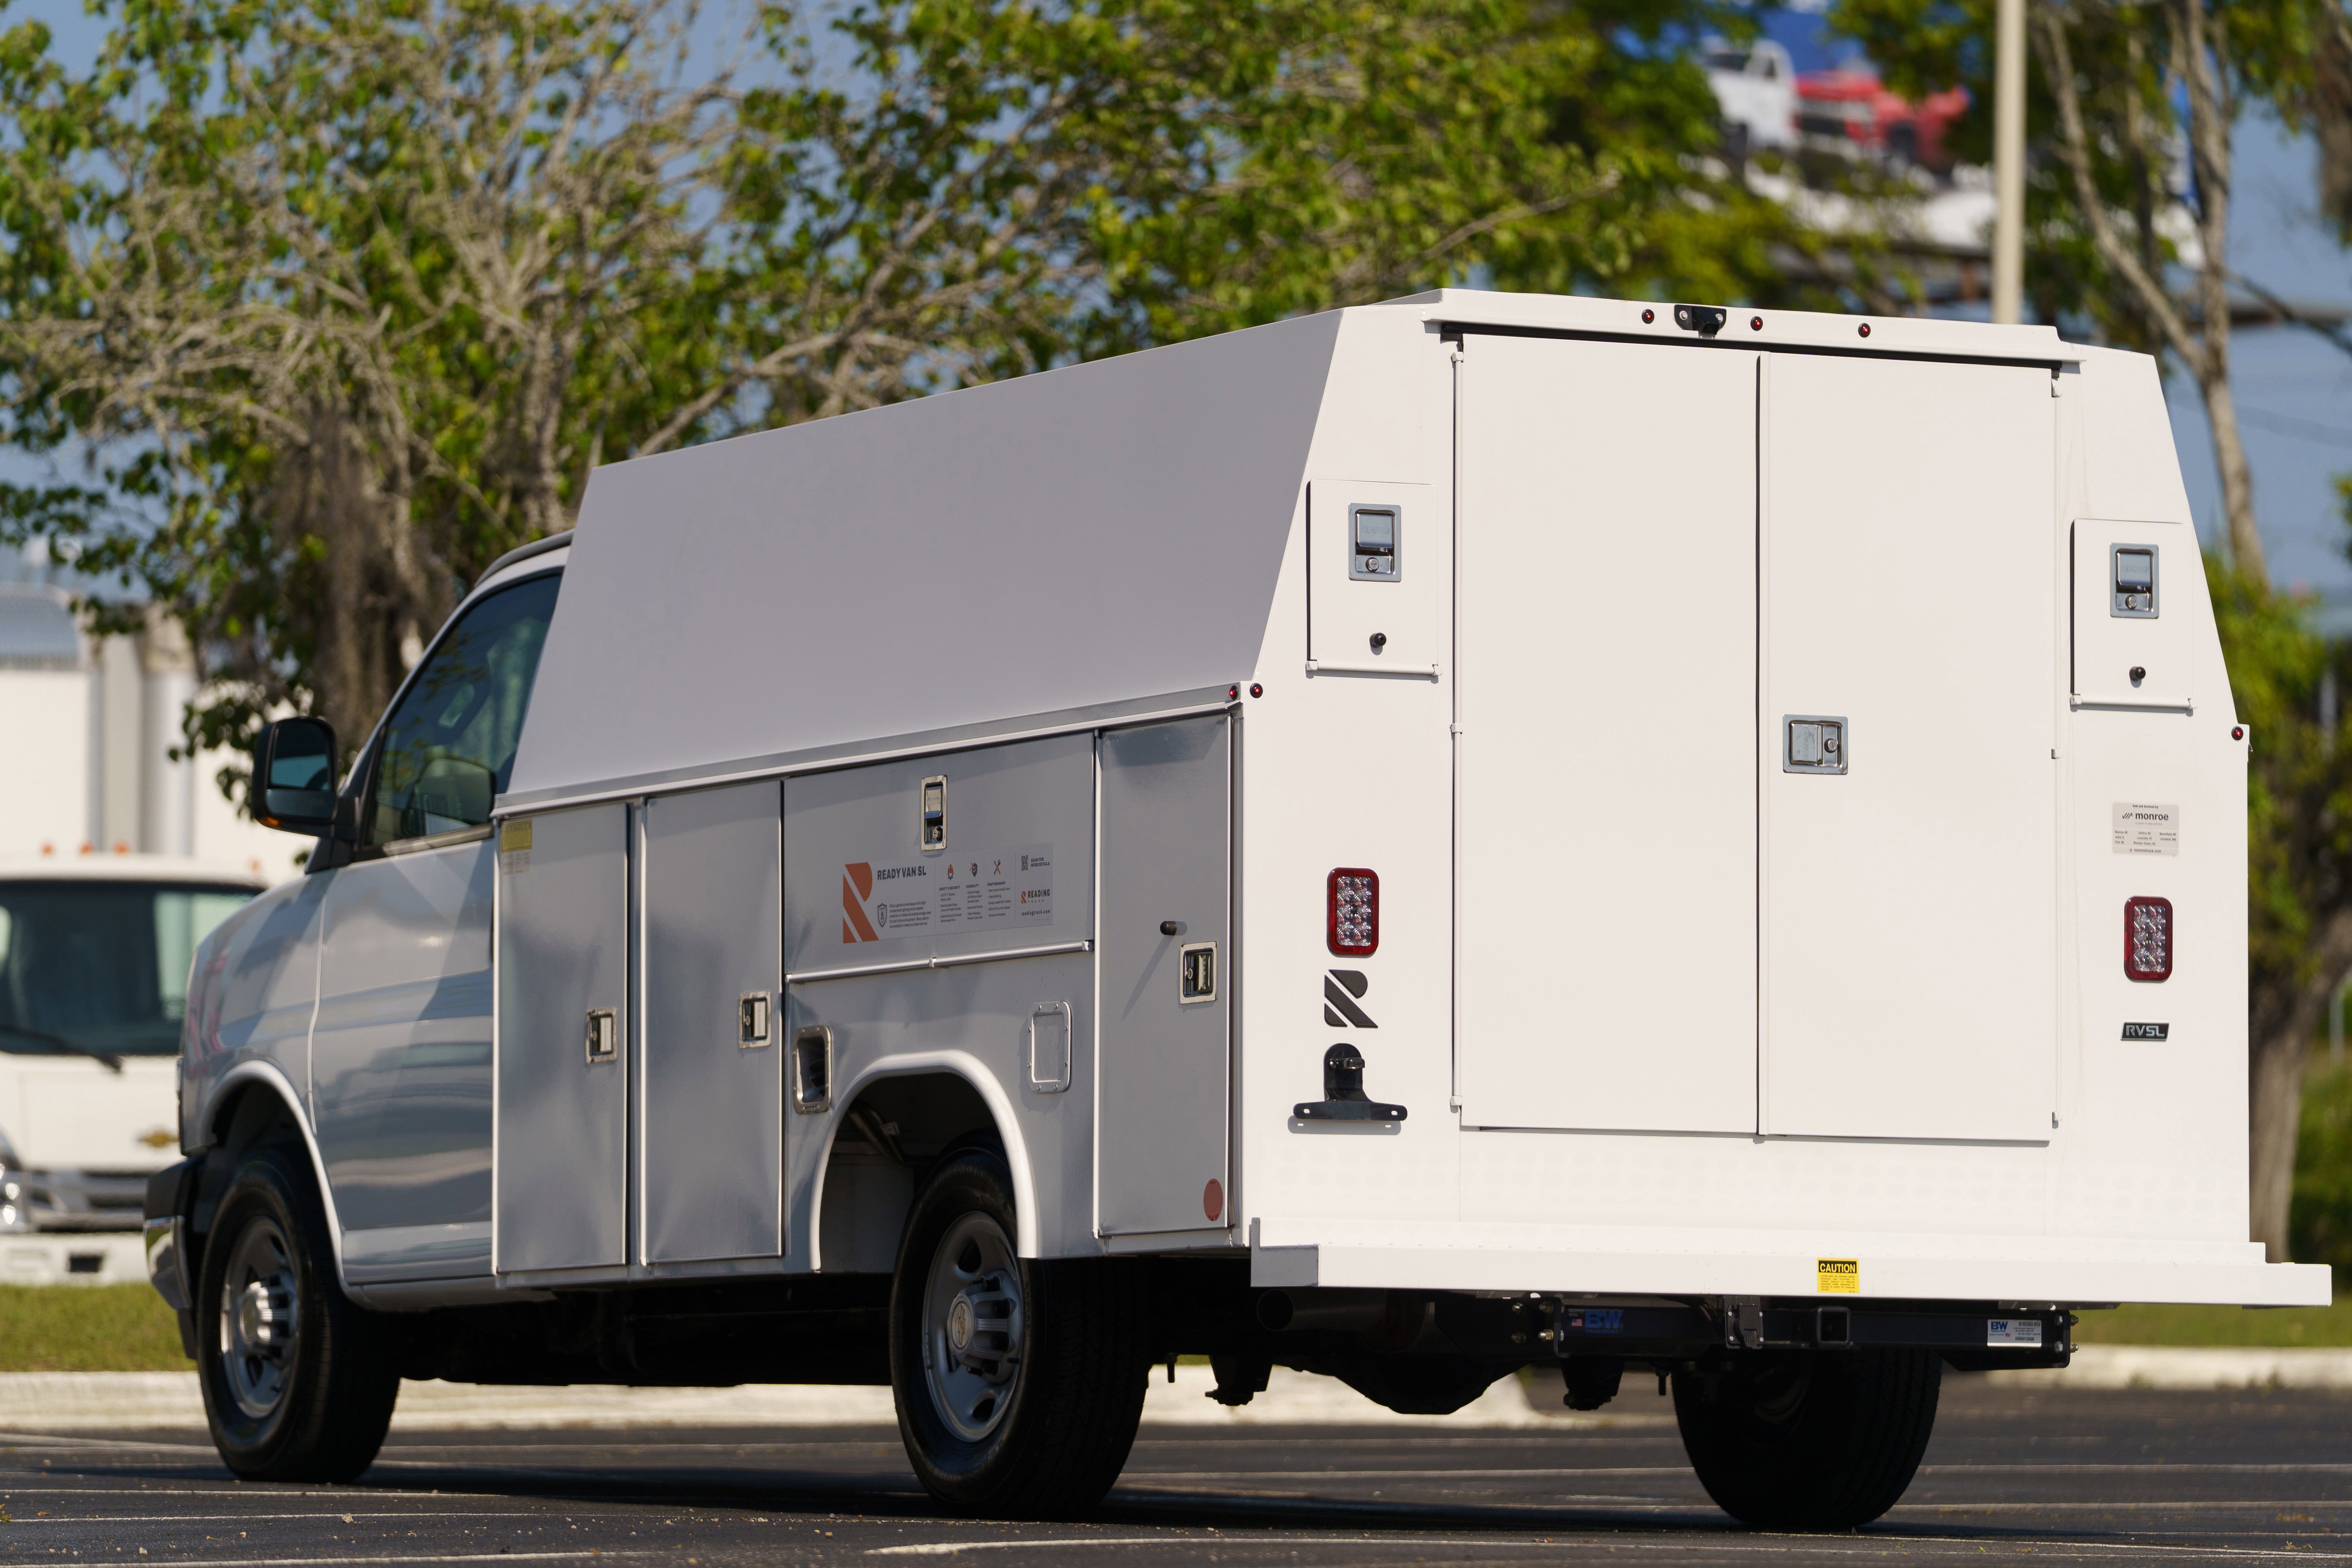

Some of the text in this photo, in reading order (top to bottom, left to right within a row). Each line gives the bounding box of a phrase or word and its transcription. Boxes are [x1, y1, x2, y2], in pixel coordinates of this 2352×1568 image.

[878, 866, 927, 880] READY VAN SL
[1028, 889, 1050, 898] READING
[2126, 1025, 2165, 1037] RVSL
[1820, 1263, 1855, 1273] CAUTION
